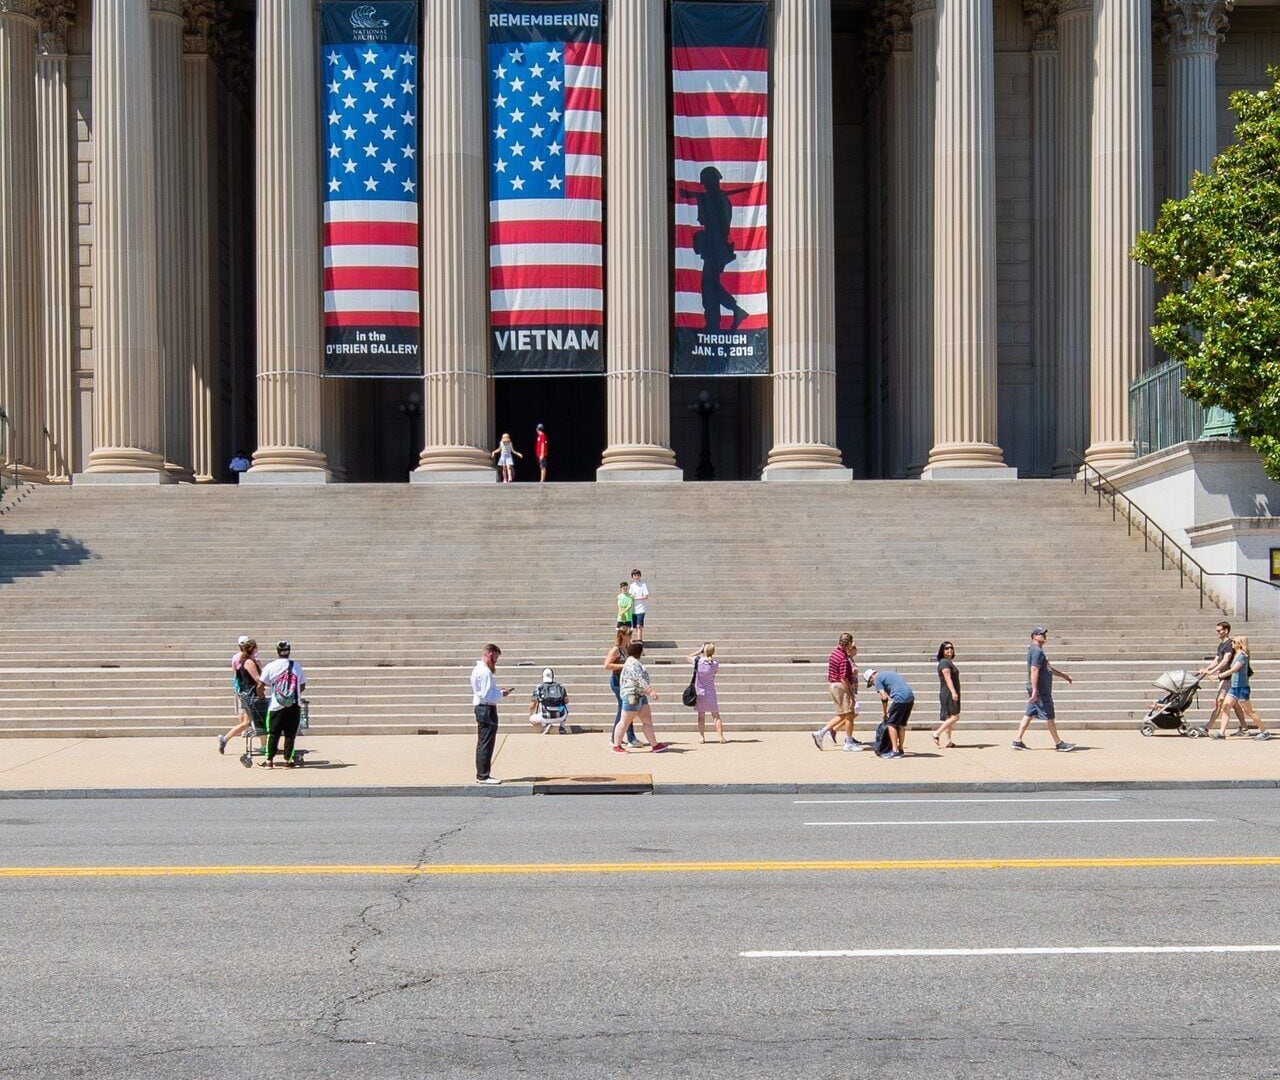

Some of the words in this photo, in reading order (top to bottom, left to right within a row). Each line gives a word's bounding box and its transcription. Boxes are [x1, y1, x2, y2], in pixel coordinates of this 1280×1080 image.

[489, 13, 599, 27] REMEMBERING
[356, 331, 366, 341] in
[368, 331, 386, 341] the
[494, 329, 599, 351] VIETNAM
[697, 333, 747, 344] THROUGH
[326, 343, 368, 354] O'BRIEN
[370, 343, 418, 354] GALLERY
[691, 345, 715, 356] JAN.
[717, 346, 727, 358] 6,
[729, 346, 754, 356] 2019
